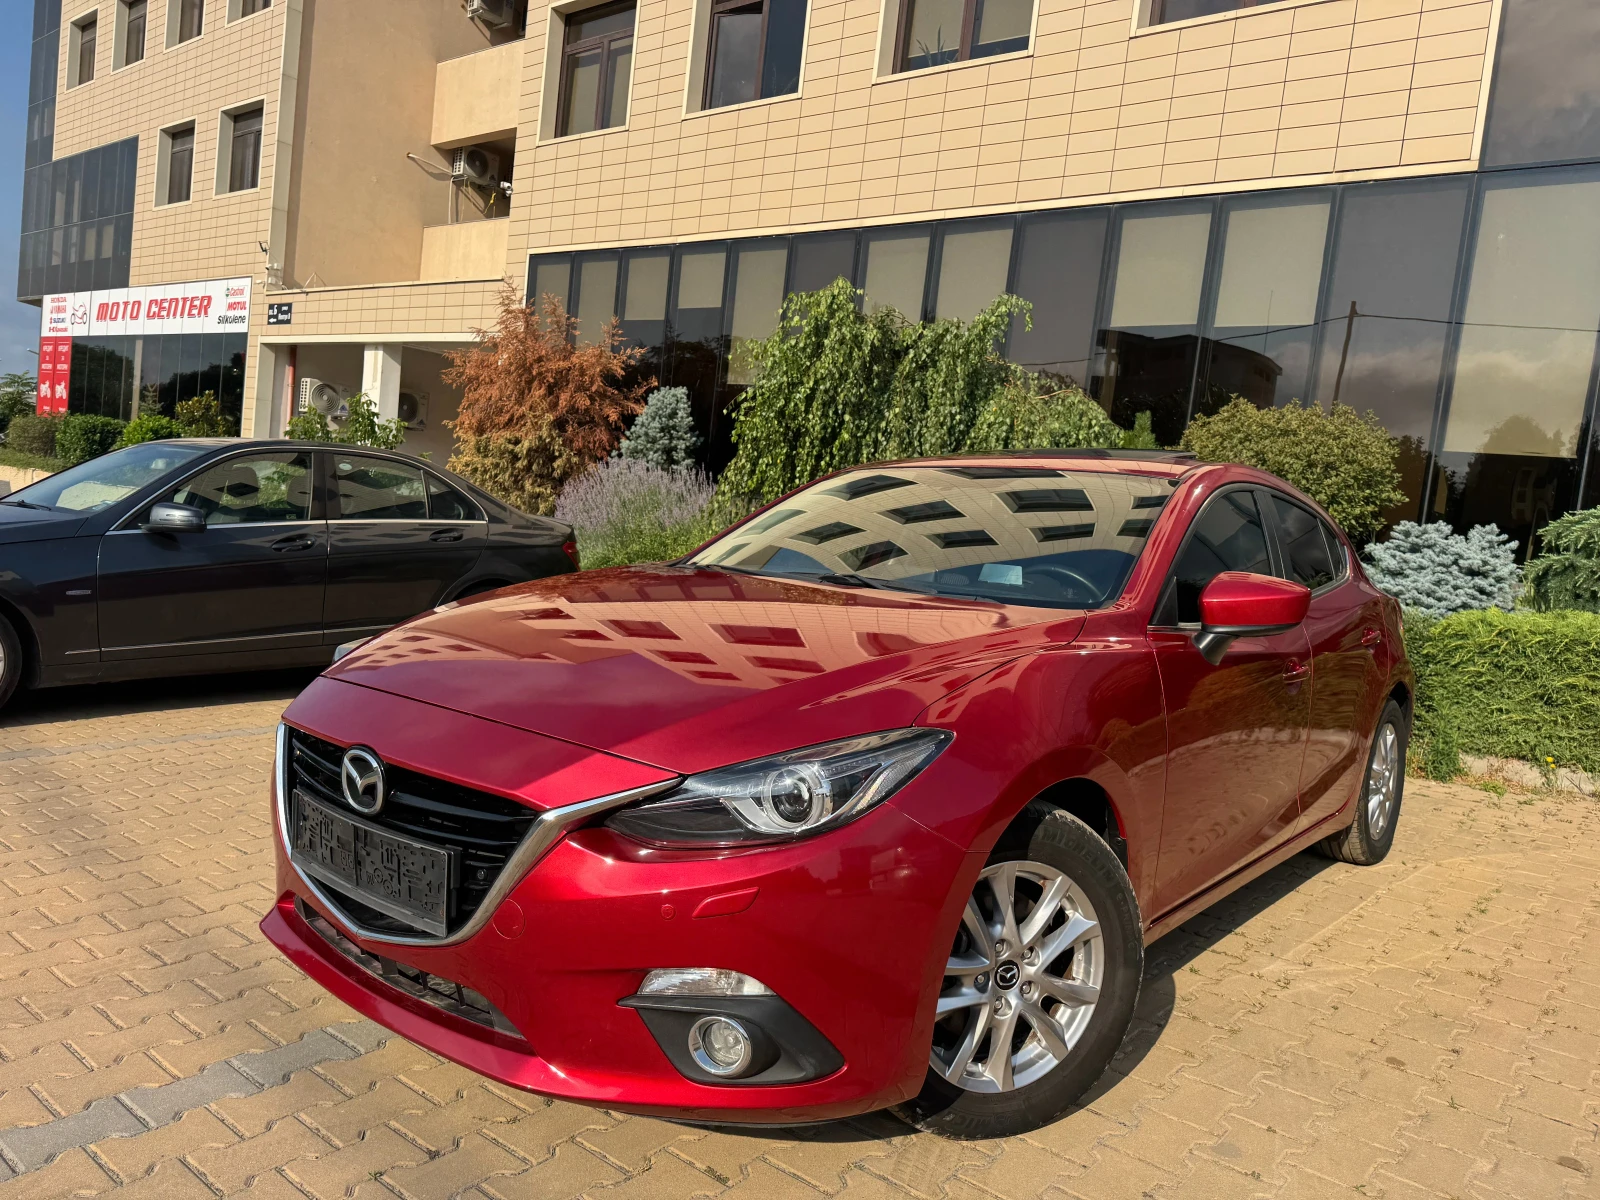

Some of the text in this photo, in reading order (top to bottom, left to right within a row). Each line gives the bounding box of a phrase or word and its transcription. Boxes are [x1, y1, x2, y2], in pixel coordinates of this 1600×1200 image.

[230, 286, 245, 297] Castrol
[96, 295, 212, 322] MOTO CENTER
[227, 301, 247, 310] MOTUL
[1040, 825, 1116, 883] MICHELIN
